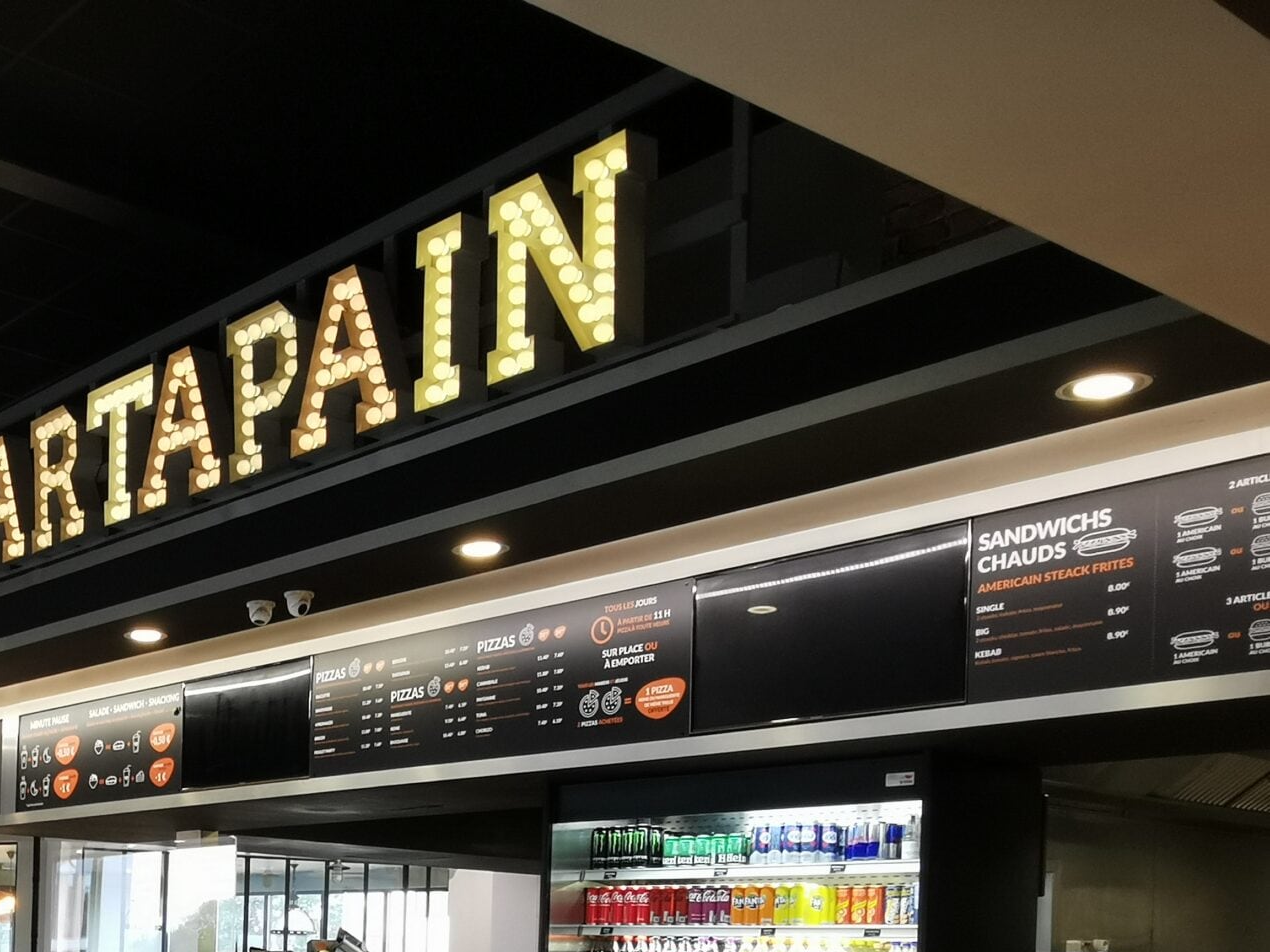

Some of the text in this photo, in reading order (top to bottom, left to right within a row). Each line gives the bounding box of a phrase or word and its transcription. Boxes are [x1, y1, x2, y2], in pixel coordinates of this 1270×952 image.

[1229, 481, 1235, 489] 2
[978, 508, 1112, 552] SANDWICHS
[977, 541, 1067, 573] CHAUDS
[978, 557, 1135, 594] AMERICAIN STEACK FRITES
[605, 596, 657, 613] TOUS LES JOURS
[976, 602, 1005, 615] SINGLE
[654, 610, 663, 620] 11
[664, 609, 671, 618] H
[477, 635, 516, 654] PIZZAS
[602, 641, 658, 659] SUR PLACE OU
[611, 653, 655, 668] EMPORTER
[974, 648, 1002, 659] KEBAB
[316, 667, 346, 684] PIZZAS
[391, 686, 425, 703] PIZZAS
[651, 684, 673, 694] PIZZA
[88, 706, 110, 718] SALADE
[113, 699, 145, 714] SANDWICH
[148, 693, 180, 707] SNACKING
[30, 714, 69, 730] MINUTE PAUSE
[581, 719, 598, 728] PIZZAS
